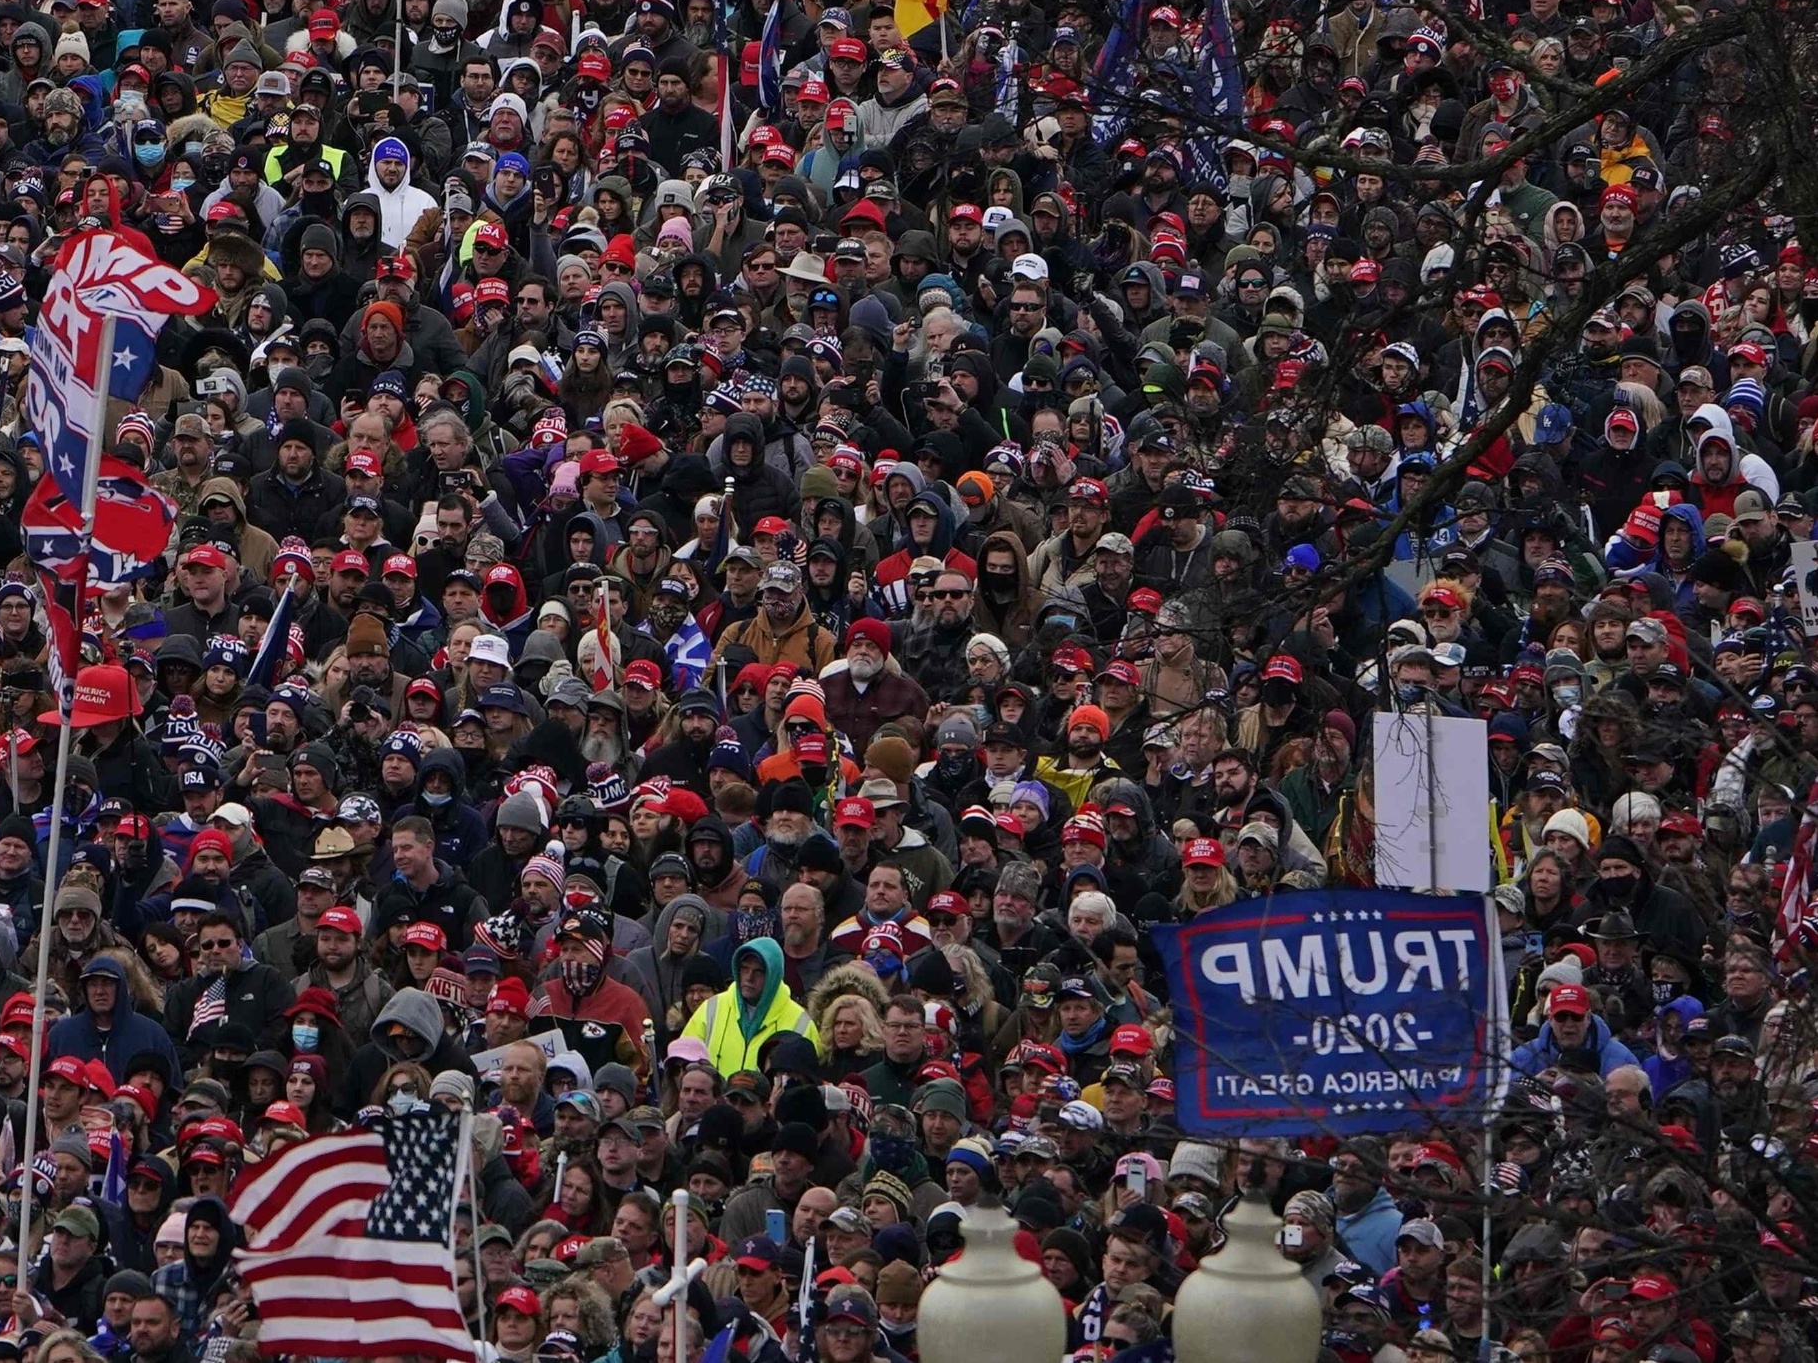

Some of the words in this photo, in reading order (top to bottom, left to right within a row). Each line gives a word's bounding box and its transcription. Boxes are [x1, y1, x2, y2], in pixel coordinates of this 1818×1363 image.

[186, 47, 198, 65] MP
[709, 173, 734, 187] FOX
[1604, 193, 1631, 203] TRUMP
[479, 224, 500, 239] USA
[374, 382, 403, 394] TRUMP
[1543, 417, 1552, 428] LA
[769, 567, 794, 576] TRUMP
[75, 686, 111, 699] AMERICA
[79, 695, 107, 705] AGAIN
[184, 771, 204, 784] USA
[1537, 771, 1561, 782] TRUMP
[100, 802, 121, 812] USA
